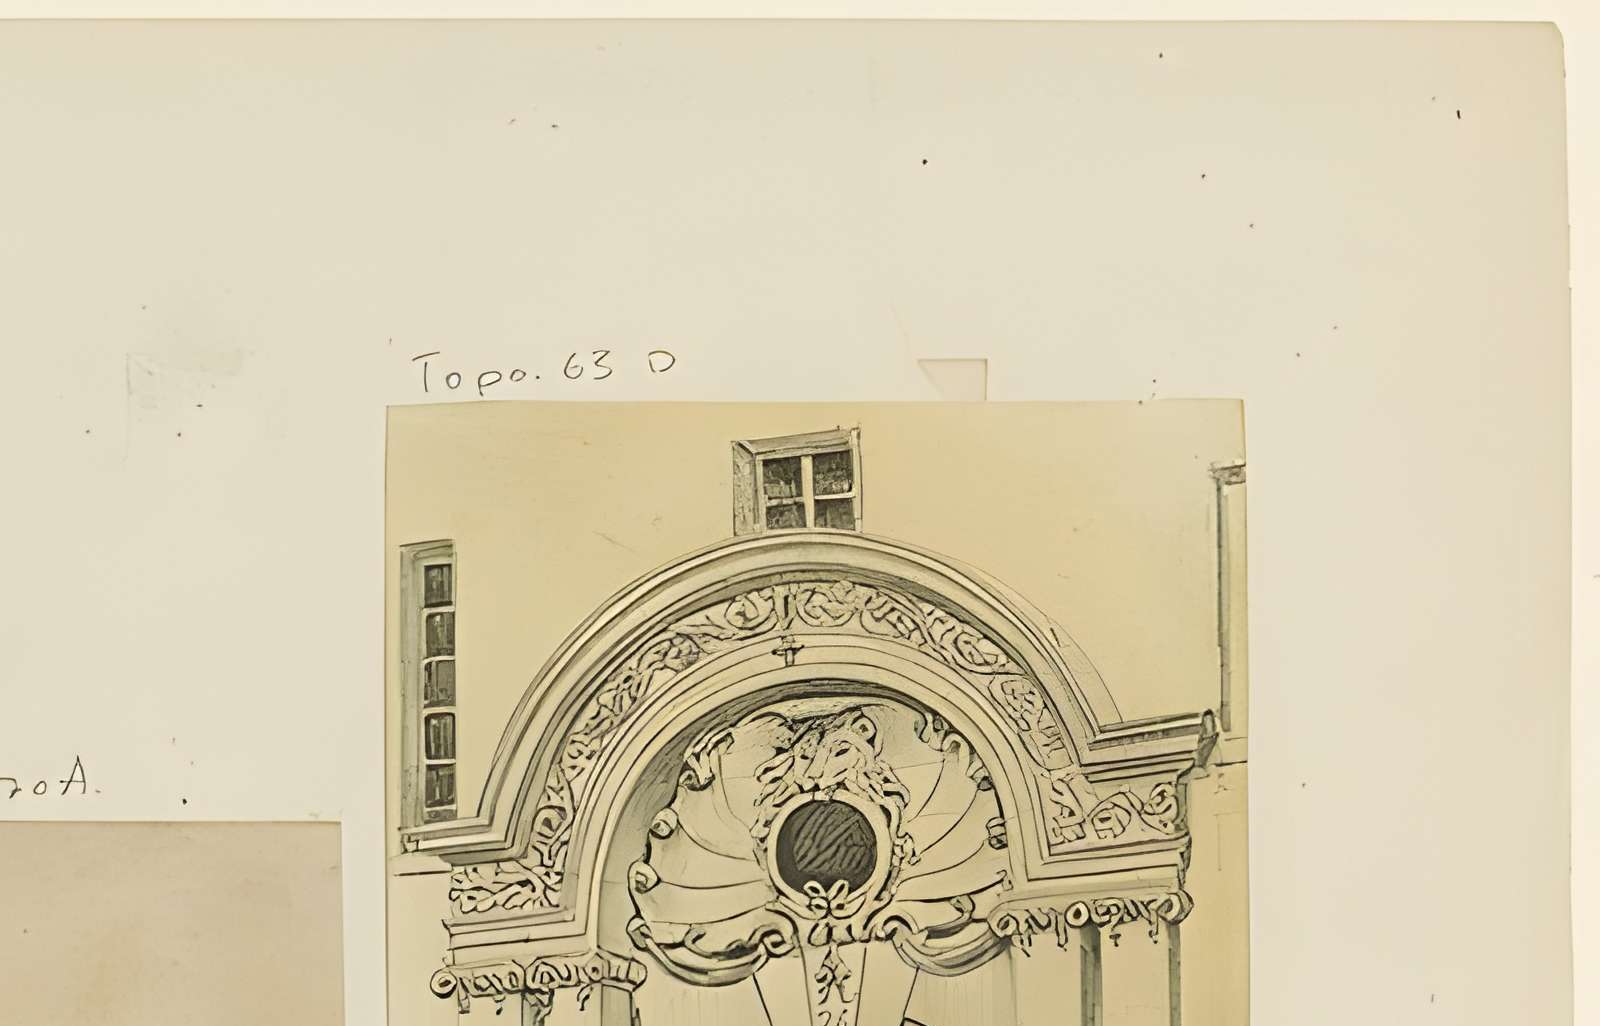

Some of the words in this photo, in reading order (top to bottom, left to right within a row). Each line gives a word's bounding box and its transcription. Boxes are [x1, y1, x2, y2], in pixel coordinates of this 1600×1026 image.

[410, 348, 542, 398] Topo.
[561, 347, 614, 381] 63
[645, 348, 677, 375] D
